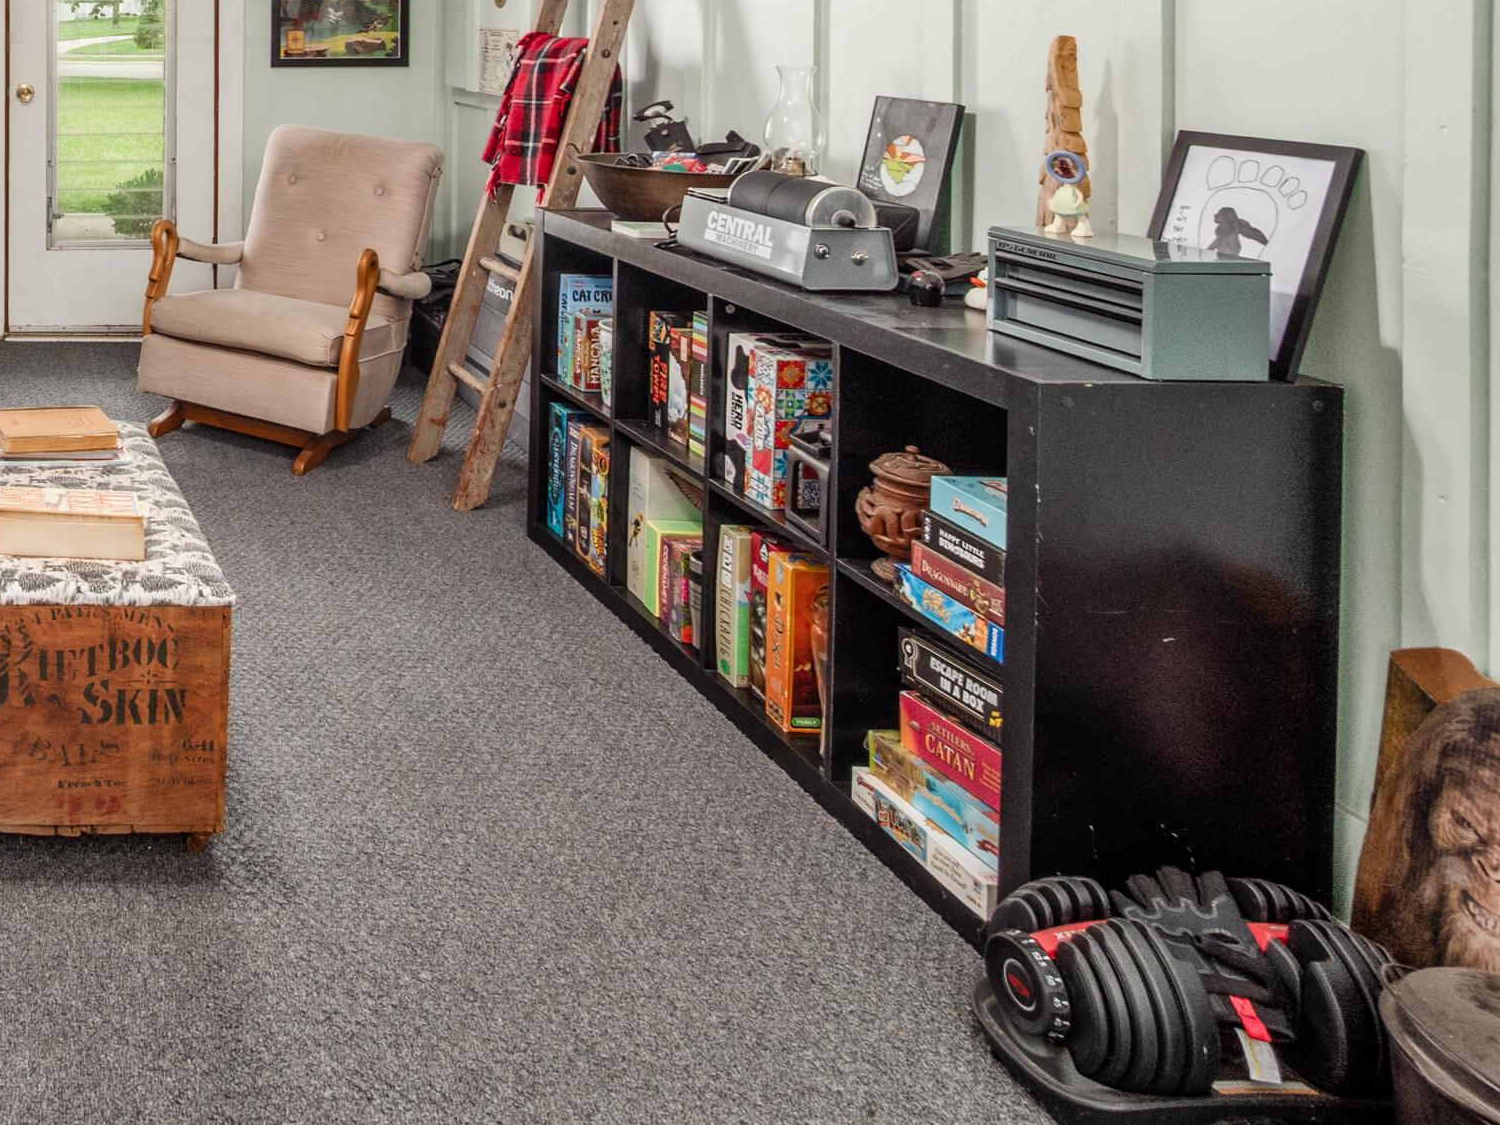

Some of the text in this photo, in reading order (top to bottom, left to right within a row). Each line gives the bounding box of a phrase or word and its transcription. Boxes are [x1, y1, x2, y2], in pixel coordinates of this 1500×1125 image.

[707, 211, 773, 248] CENTRAL
[716, 233, 758, 253] MACHINERY
[1014, 244, 1058, 261] GENERAL
[572, 289, 592, 303] CAT
[573, 329, 582, 374] MANCALA
[590, 326, 601, 384] MANCALA
[652, 355, 661, 404] TOWER
[659, 360, 668, 404] FIRE
[735, 394, 743, 430] HERD
[938, 536, 985, 570] DINOSAURS
[939, 528, 985, 560] HAPPY LITTLE
[661, 544, 670, 605] CODENAMES
[50, 606, 111, 621] PAIRS
[718, 588, 732, 661] CHICKAPIG
[930, 656, 998, 708] ESCAPE ROOM
[940, 676, 985, 714] IN A BOX
[77, 679, 186, 725] SKIN
[931, 721, 971, 753] SETTLERS
[924, 733, 976, 781] CATAN
[56, 778, 102, 790] French
